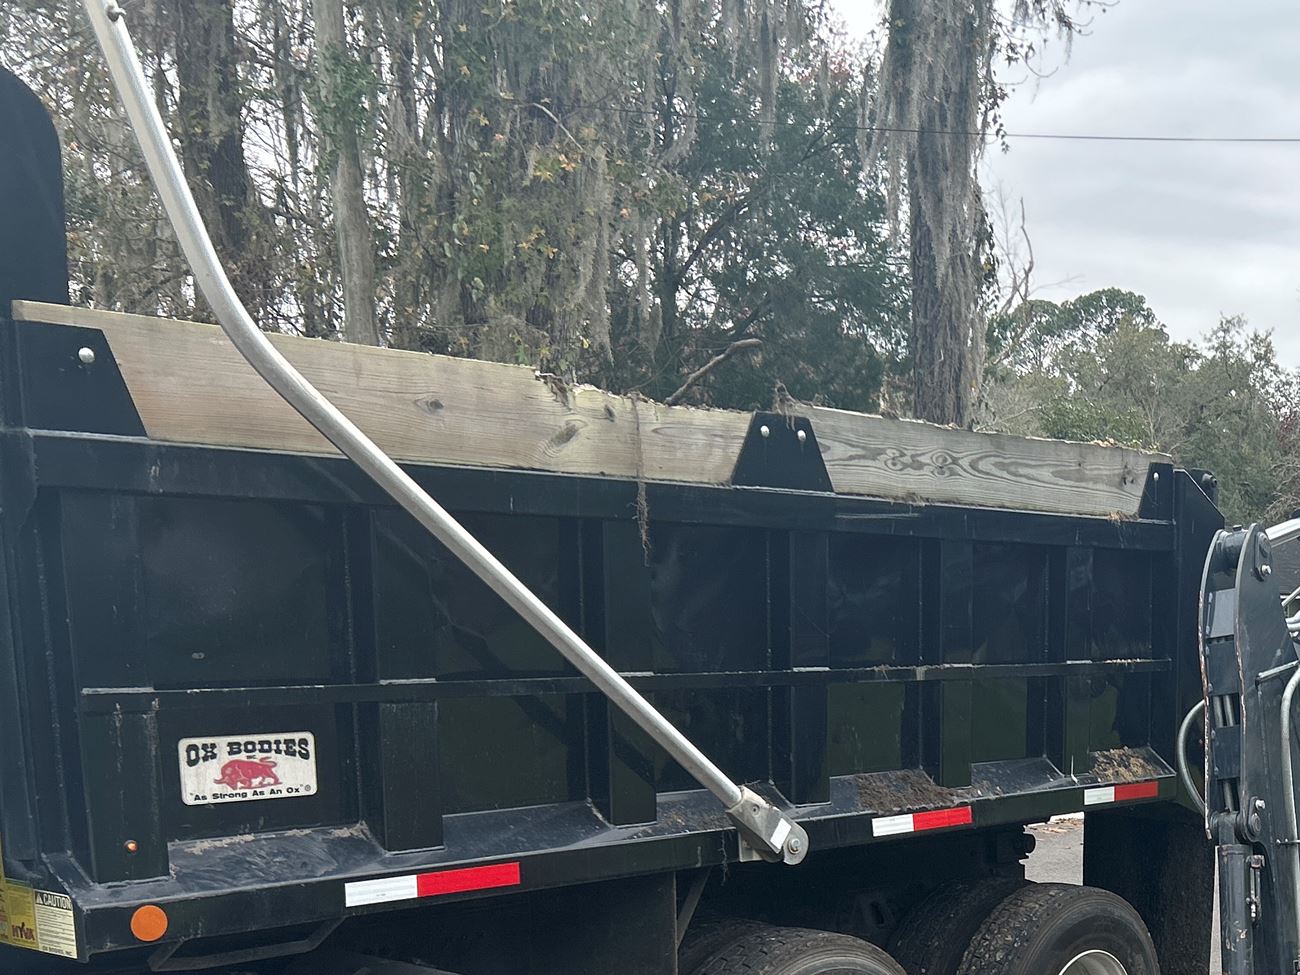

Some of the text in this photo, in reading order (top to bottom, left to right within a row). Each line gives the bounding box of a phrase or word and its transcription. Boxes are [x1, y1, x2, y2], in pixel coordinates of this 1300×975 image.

[185, 738, 311, 768] OX BODIES
[211, 791, 248, 800] Strong
[252, 789, 265, 798] As
[269, 788, 283, 796] An
